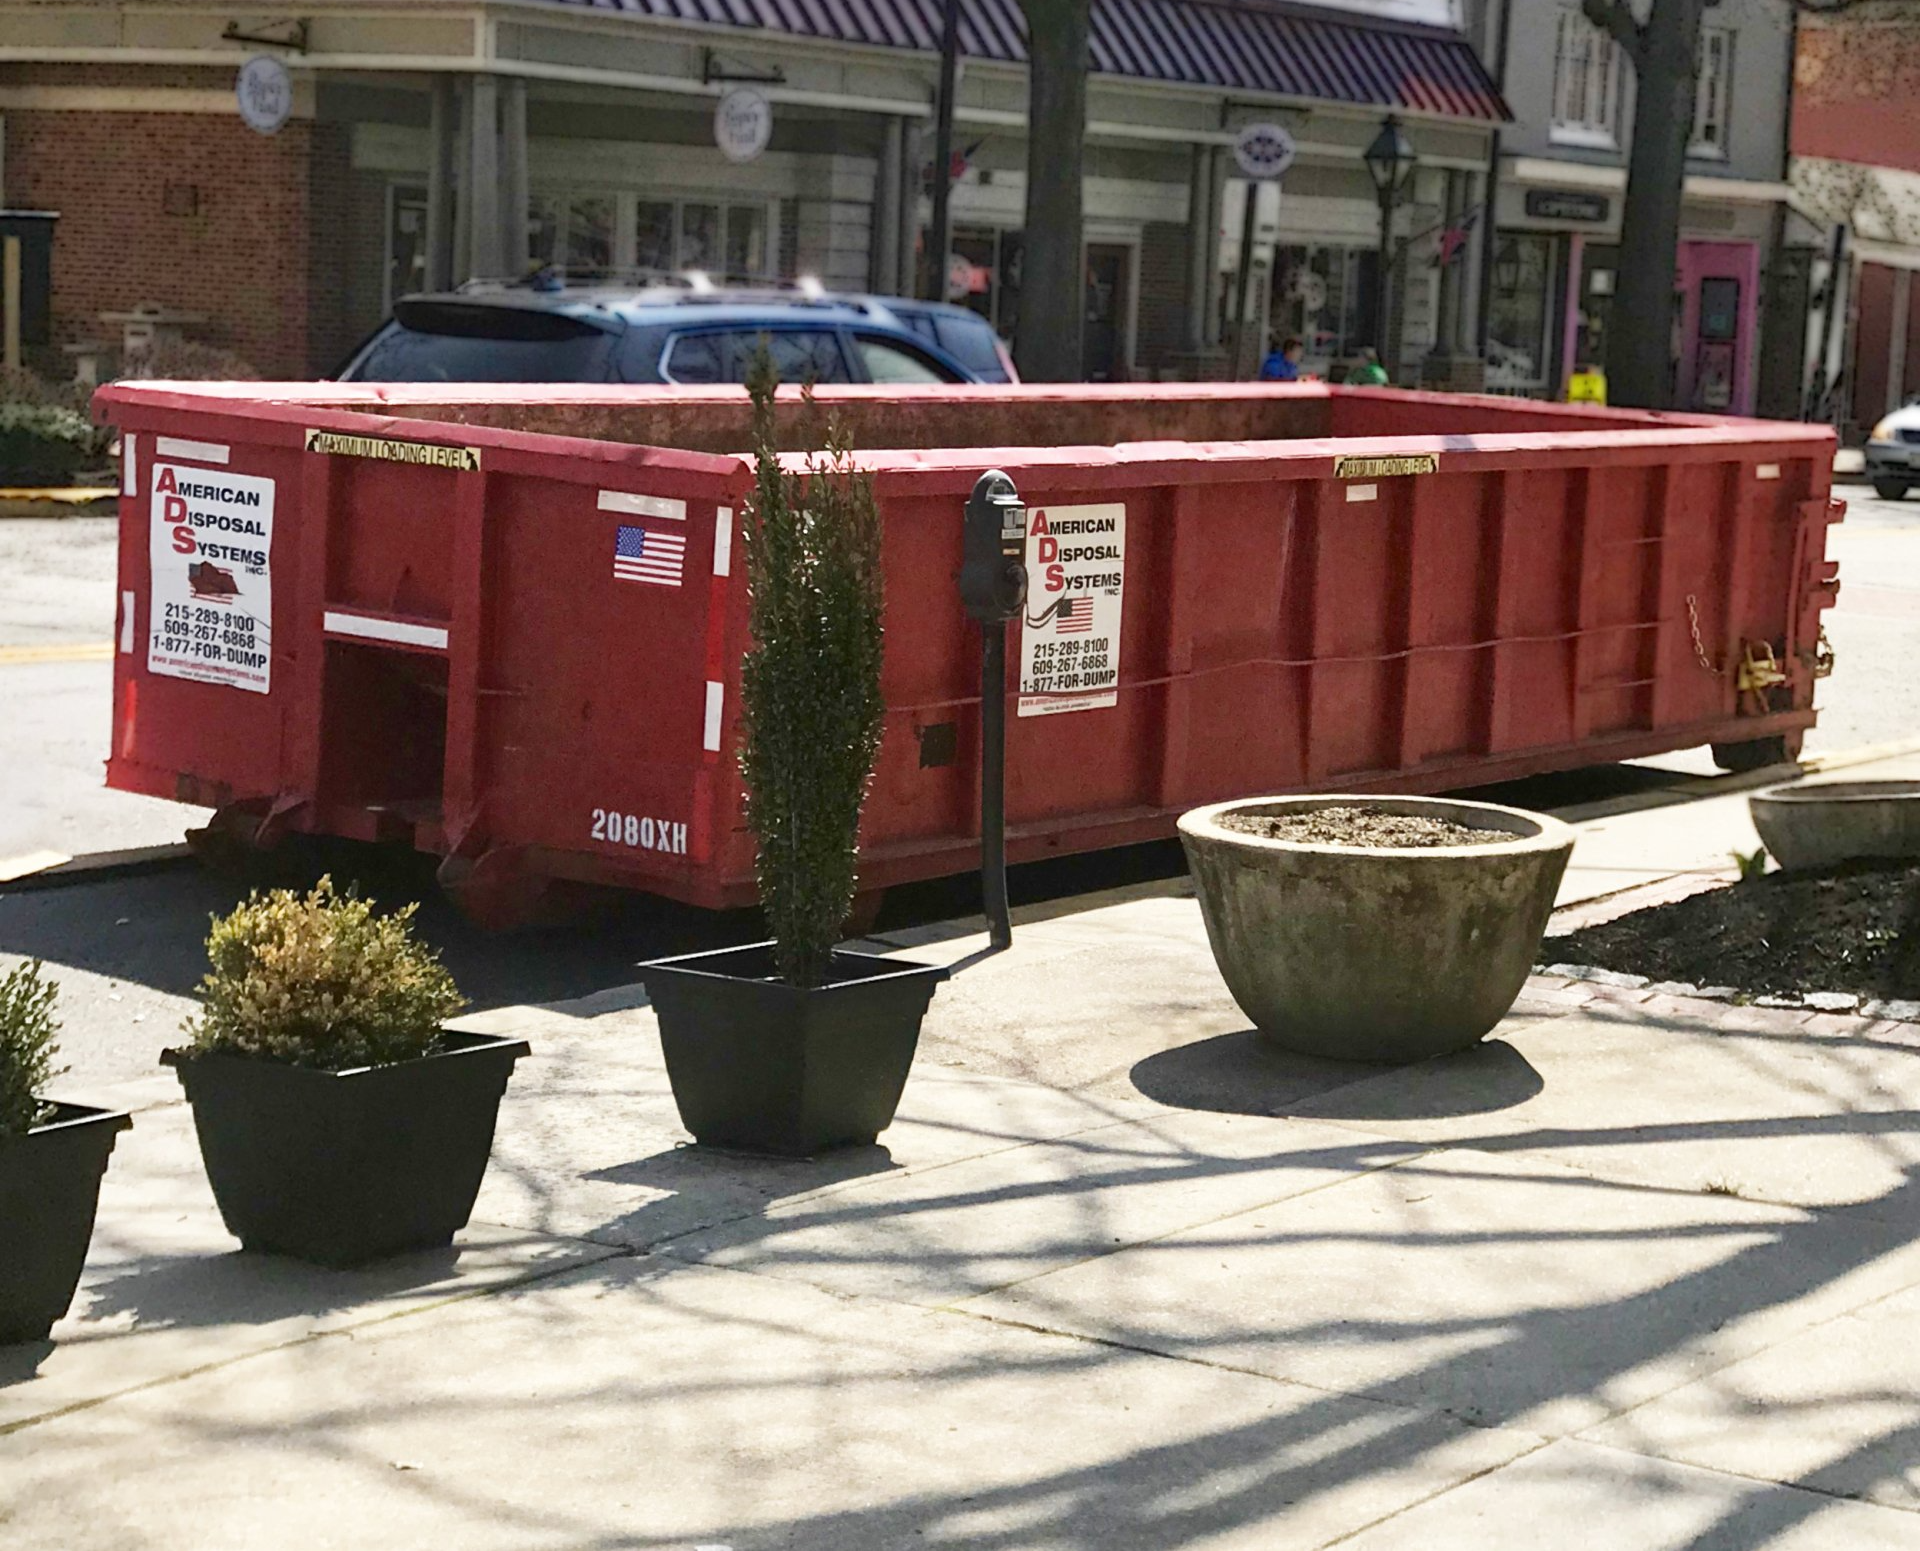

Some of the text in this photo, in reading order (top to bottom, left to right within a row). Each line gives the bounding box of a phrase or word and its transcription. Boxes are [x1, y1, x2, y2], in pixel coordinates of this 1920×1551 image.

[319, 433, 467, 470] MAXIMUM LOADING LEVEL
[156, 467, 260, 507] AMERICAN
[164, 495, 266, 537] DISPOSAL
[1030, 509, 1115, 536] AMERICAN
[172, 525, 266, 567] SYSTEMS
[1038, 537, 1120, 564] DISPOSAL
[1045, 564, 1121, 592] SYSTEMS
[165, 602, 255, 632] 215-289-8100
[164, 619, 255, 650] 609-267-6868
[1034, 637, 1109, 659] 215-289-8100
[153, 635, 267, 668] 1-877-FOR-DUMP
[1032, 654, 1108, 676] 609-267-6868
[1022, 670, 1116, 693] 1-877-FOR-DUMP
[591, 808, 687, 854] 2080XH
